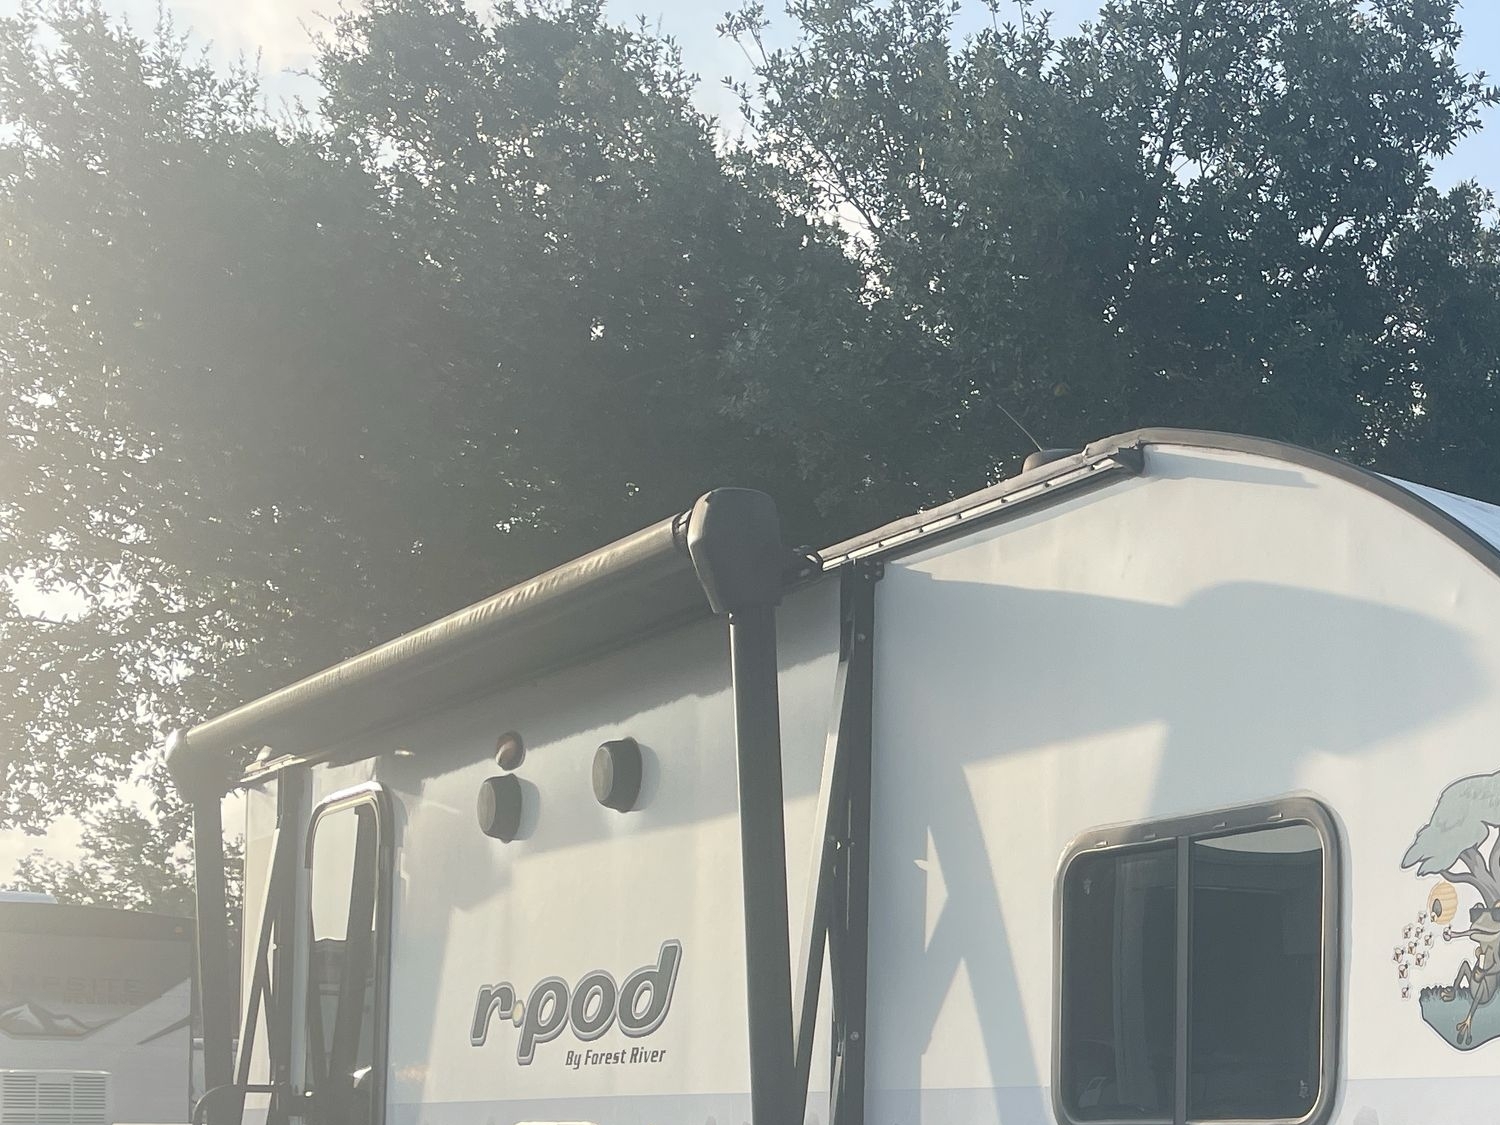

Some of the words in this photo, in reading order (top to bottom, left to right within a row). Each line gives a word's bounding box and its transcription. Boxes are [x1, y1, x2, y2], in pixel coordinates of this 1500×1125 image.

[564, 1050, 581, 1071] By
[584, 1049, 627, 1066] Forest
[630, 1047, 667, 1064] River
